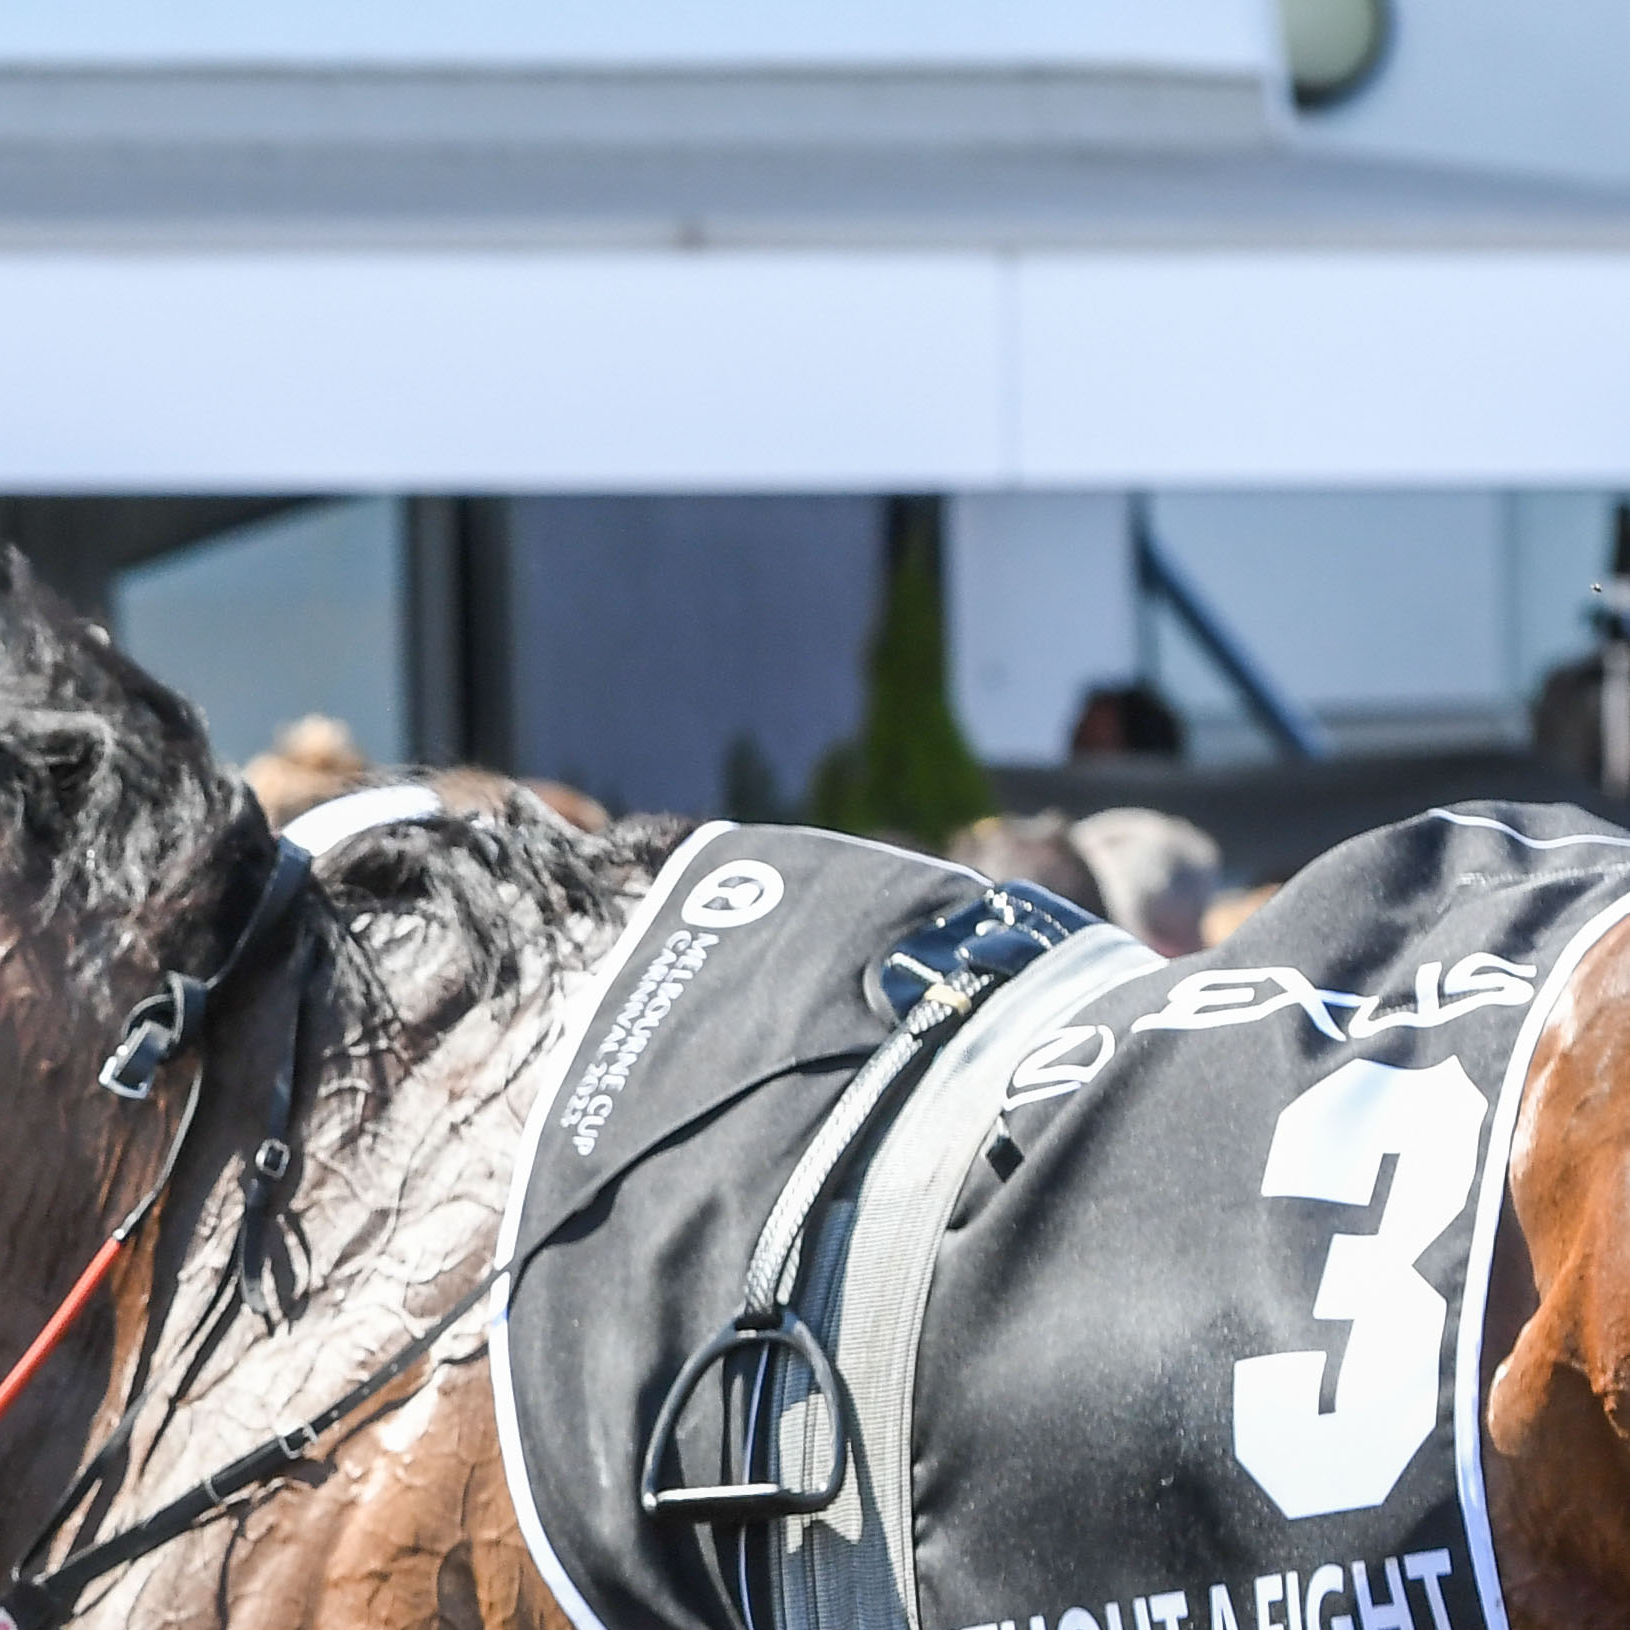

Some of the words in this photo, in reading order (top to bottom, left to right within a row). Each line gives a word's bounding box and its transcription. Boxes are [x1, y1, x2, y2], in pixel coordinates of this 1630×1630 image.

[596, 930, 692, 1061] CARNIVAL
[599, 932, 720, 1092] MELBOURNE
[572, 1094, 613, 1156] CUP
[1231, 1055, 1490, 1521] 3
